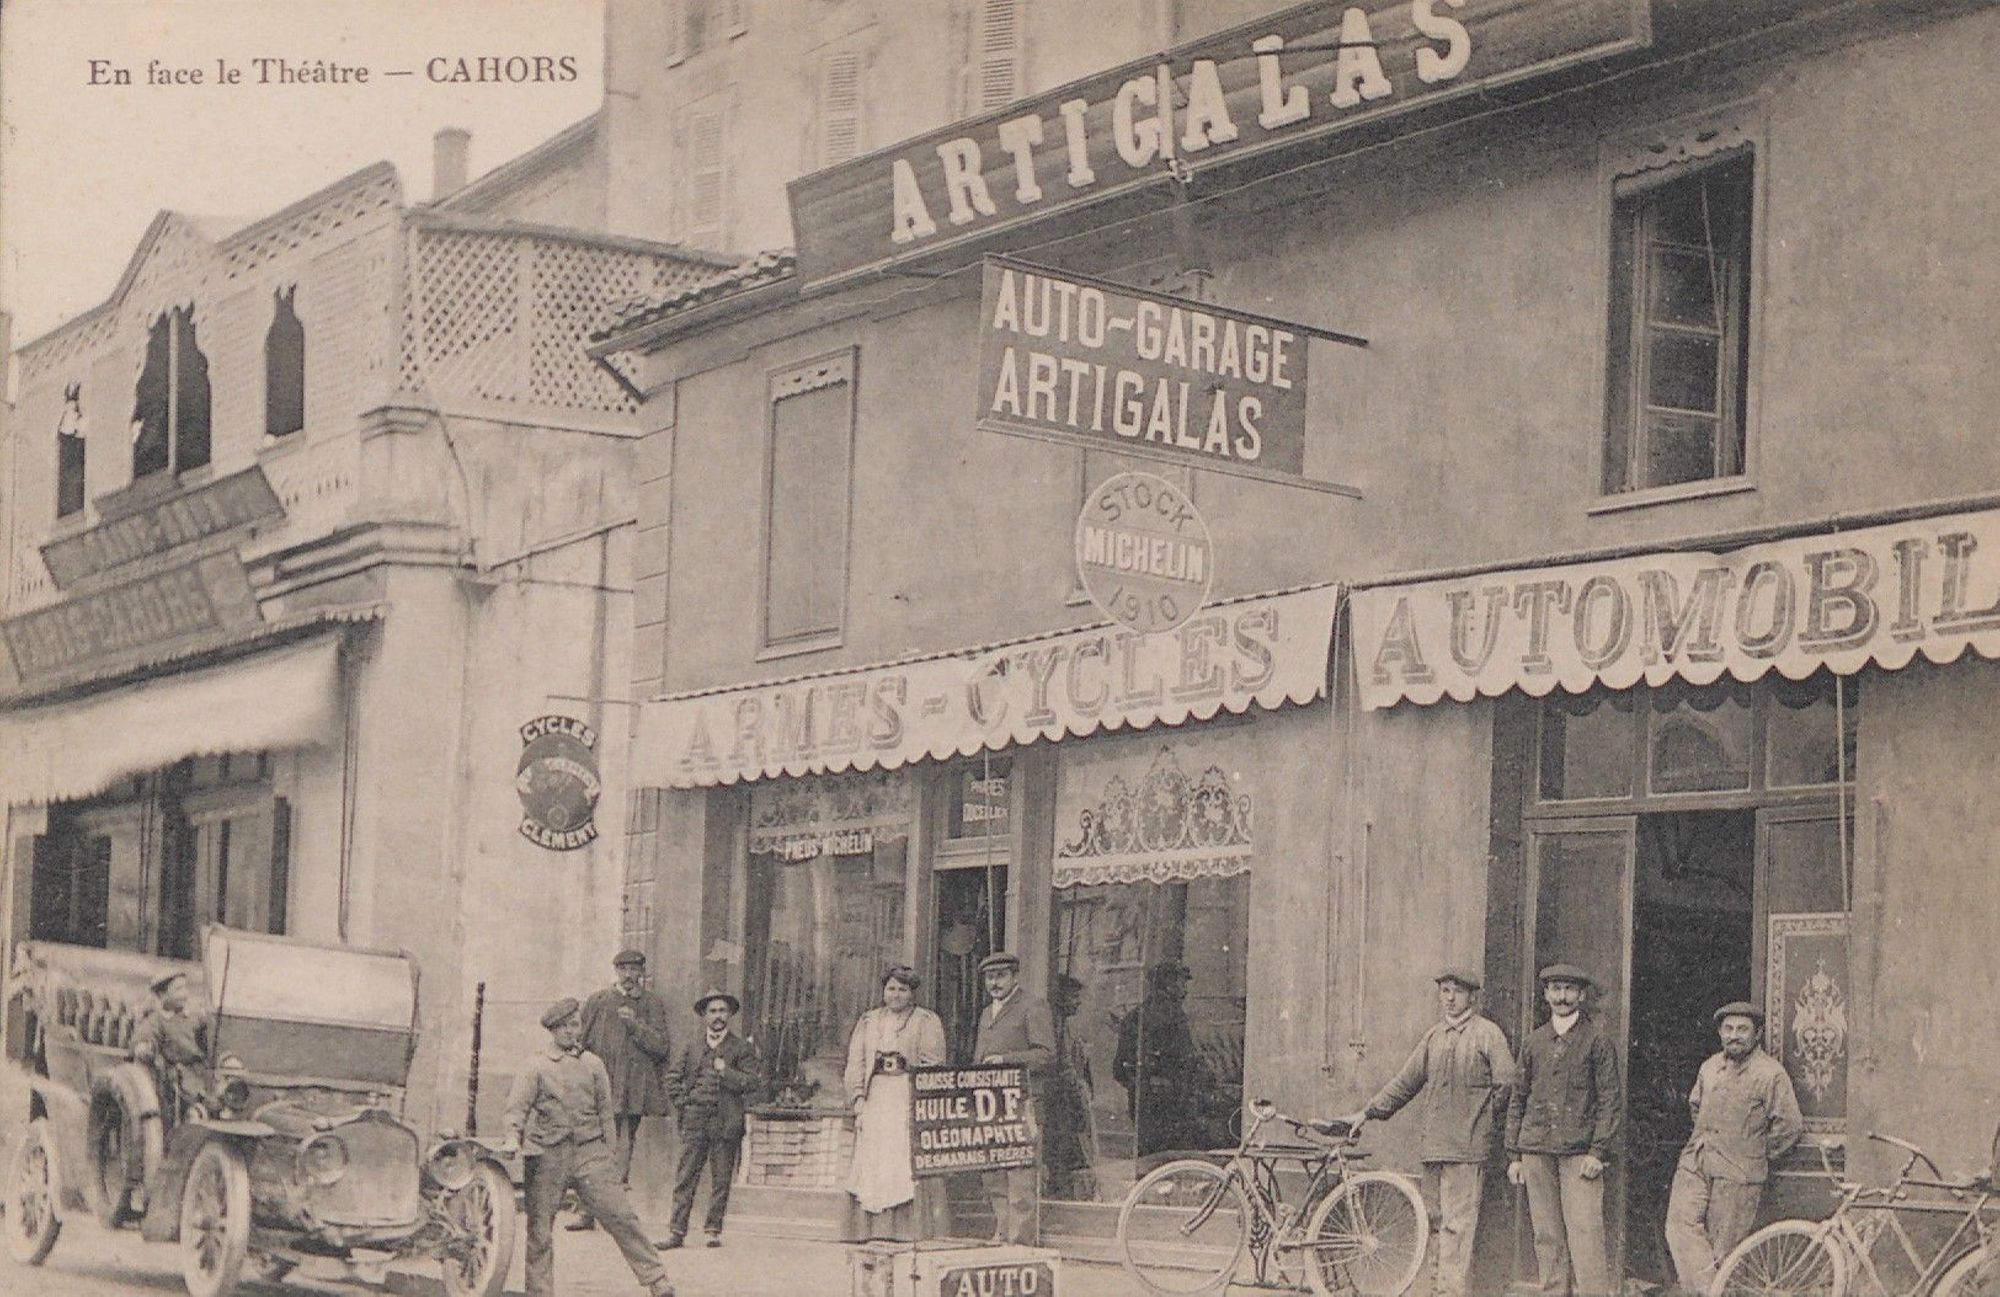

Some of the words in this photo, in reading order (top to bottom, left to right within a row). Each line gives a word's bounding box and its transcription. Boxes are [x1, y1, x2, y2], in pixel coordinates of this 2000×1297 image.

[891, 0, 1471, 243] ARTIGALAS
[994, 270, 1294, 389] AUTO-GARAGE
[991, 346, 1262, 461] ARTIGALAS
[1099, 481, 1194, 532] STOCK
[1083, 526, 1204, 585] MICHELIN
[1108, 586, 1179, 624] 1910
[522, 716, 597, 748] CYCLES
[915, 1097, 969, 1121] HUILE
[957, 1267, 1038, 1297] AUTO
